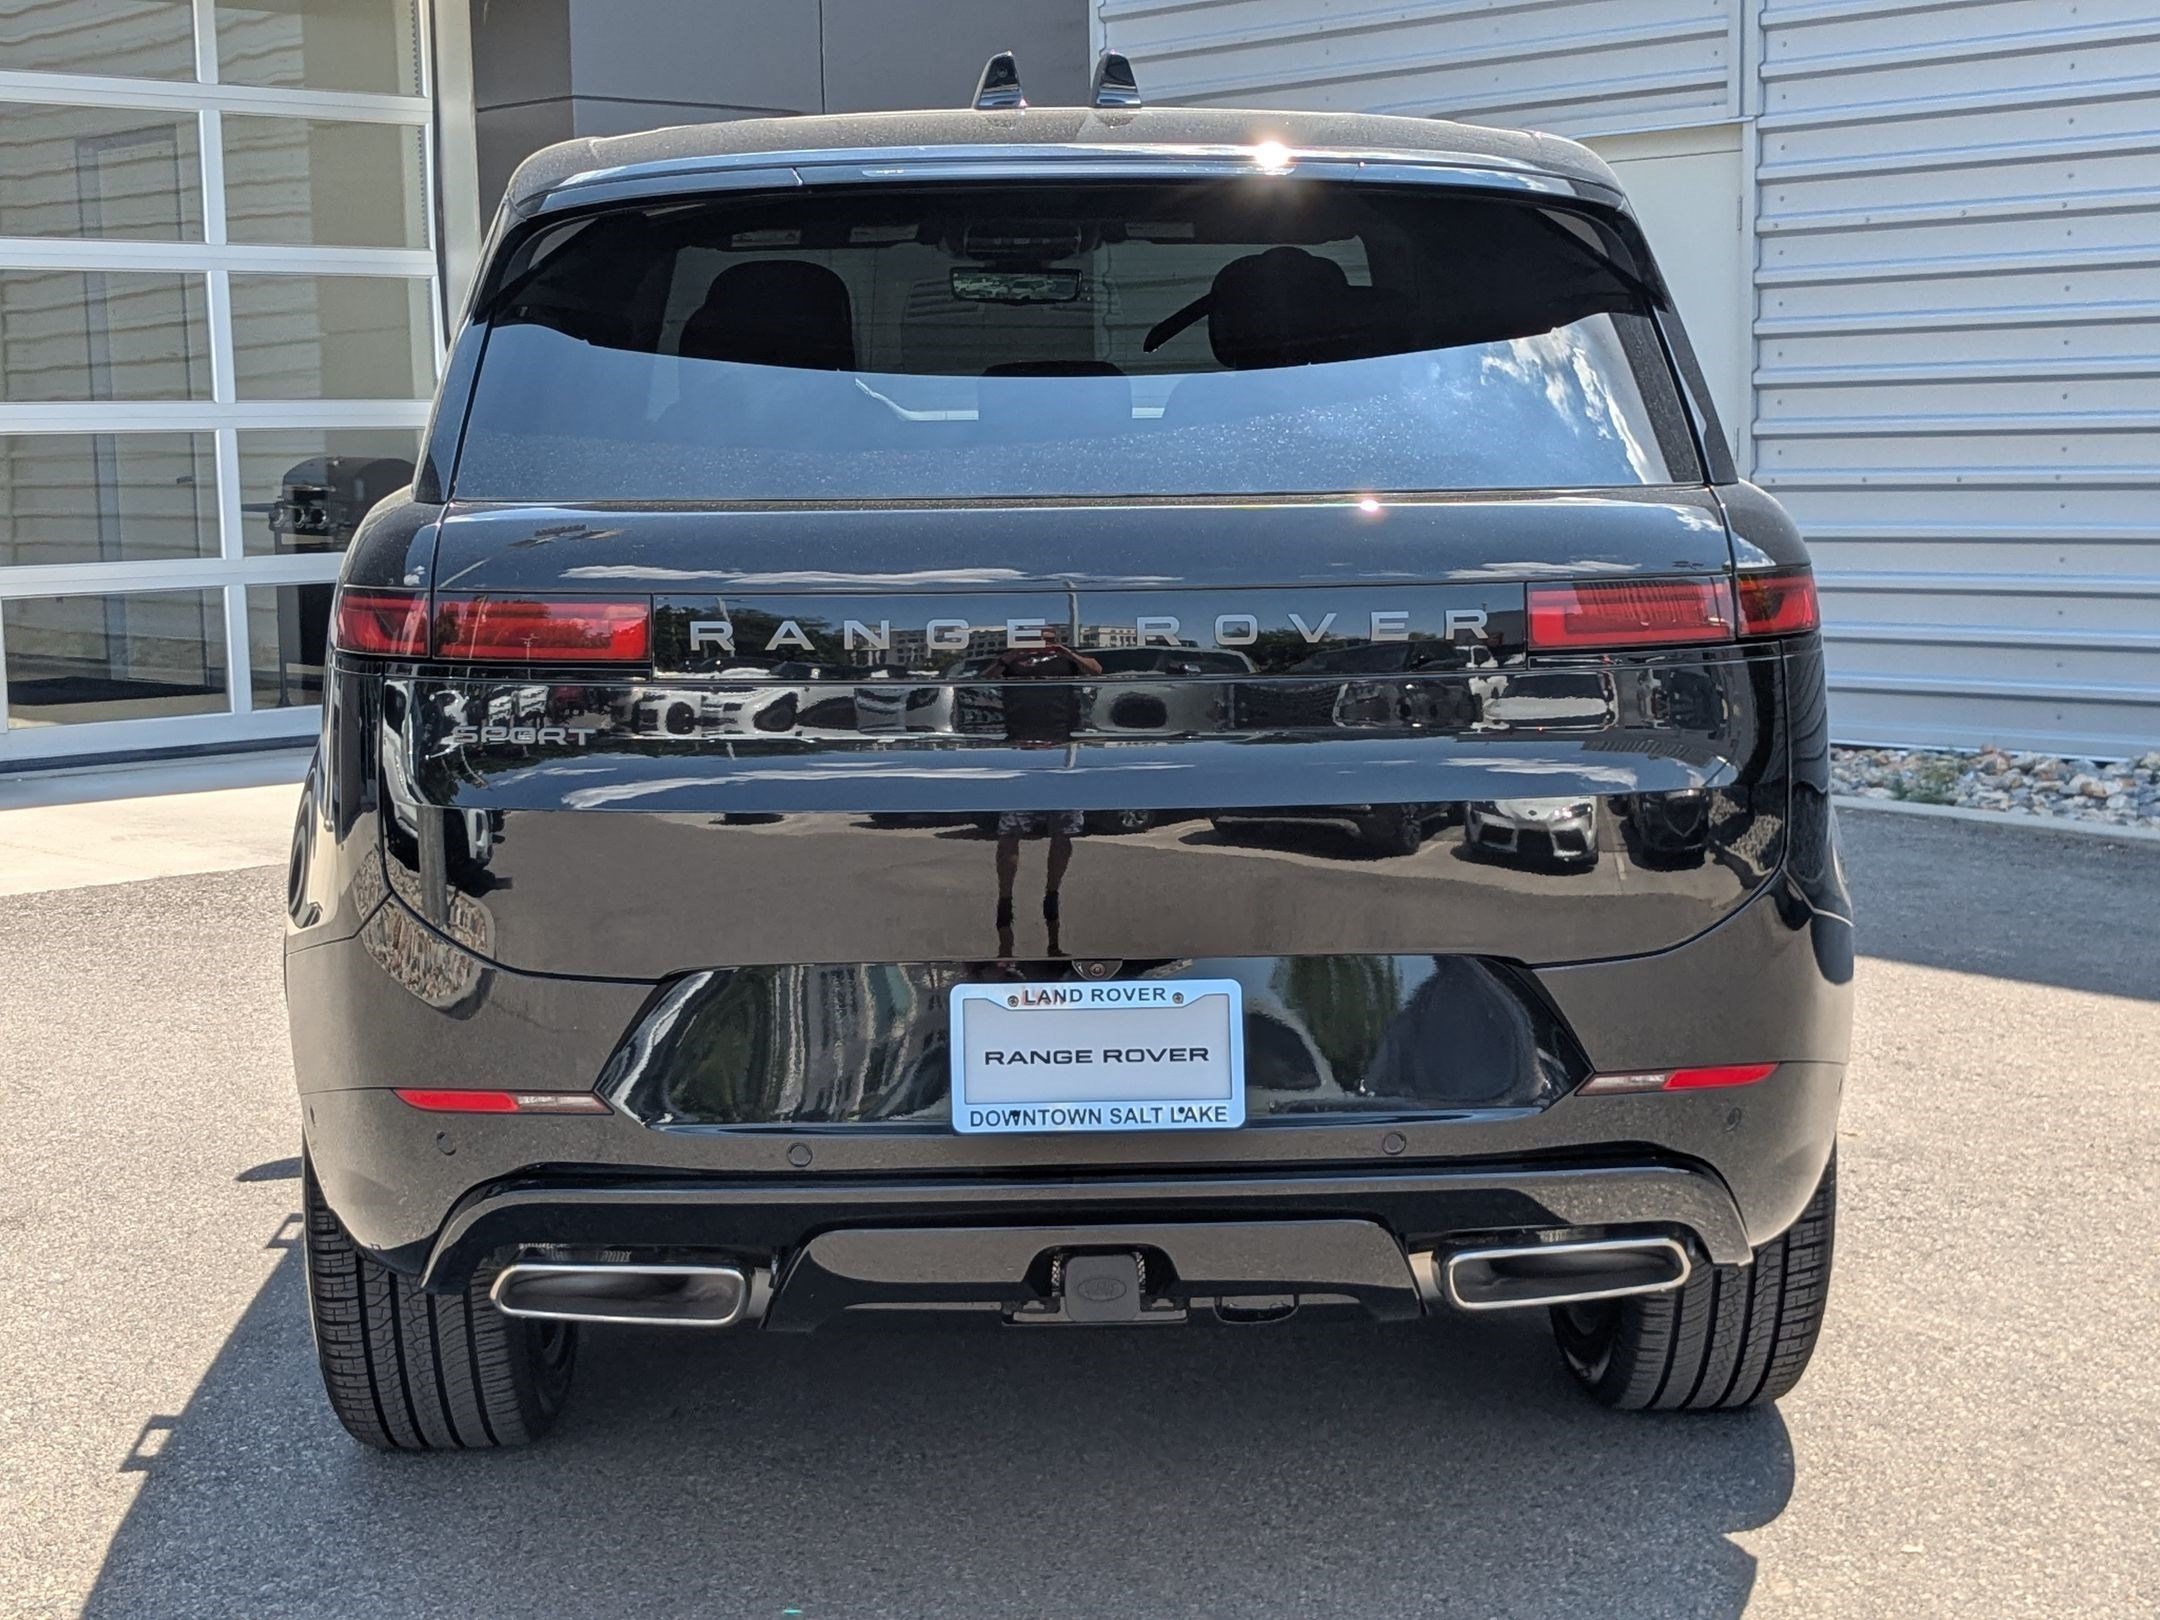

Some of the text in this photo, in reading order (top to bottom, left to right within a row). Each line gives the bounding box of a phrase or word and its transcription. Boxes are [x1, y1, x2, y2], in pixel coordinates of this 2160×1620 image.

[690, 610, 1490, 651] RANGE ROVER
[453, 726, 596, 746] SPORT
[1024, 987, 1166, 1004] LAND ROVER
[984, 1047, 1209, 1065] RANGE ROVER
[970, 1105, 1228, 1127] DOWNTOWN SALT LAKE
